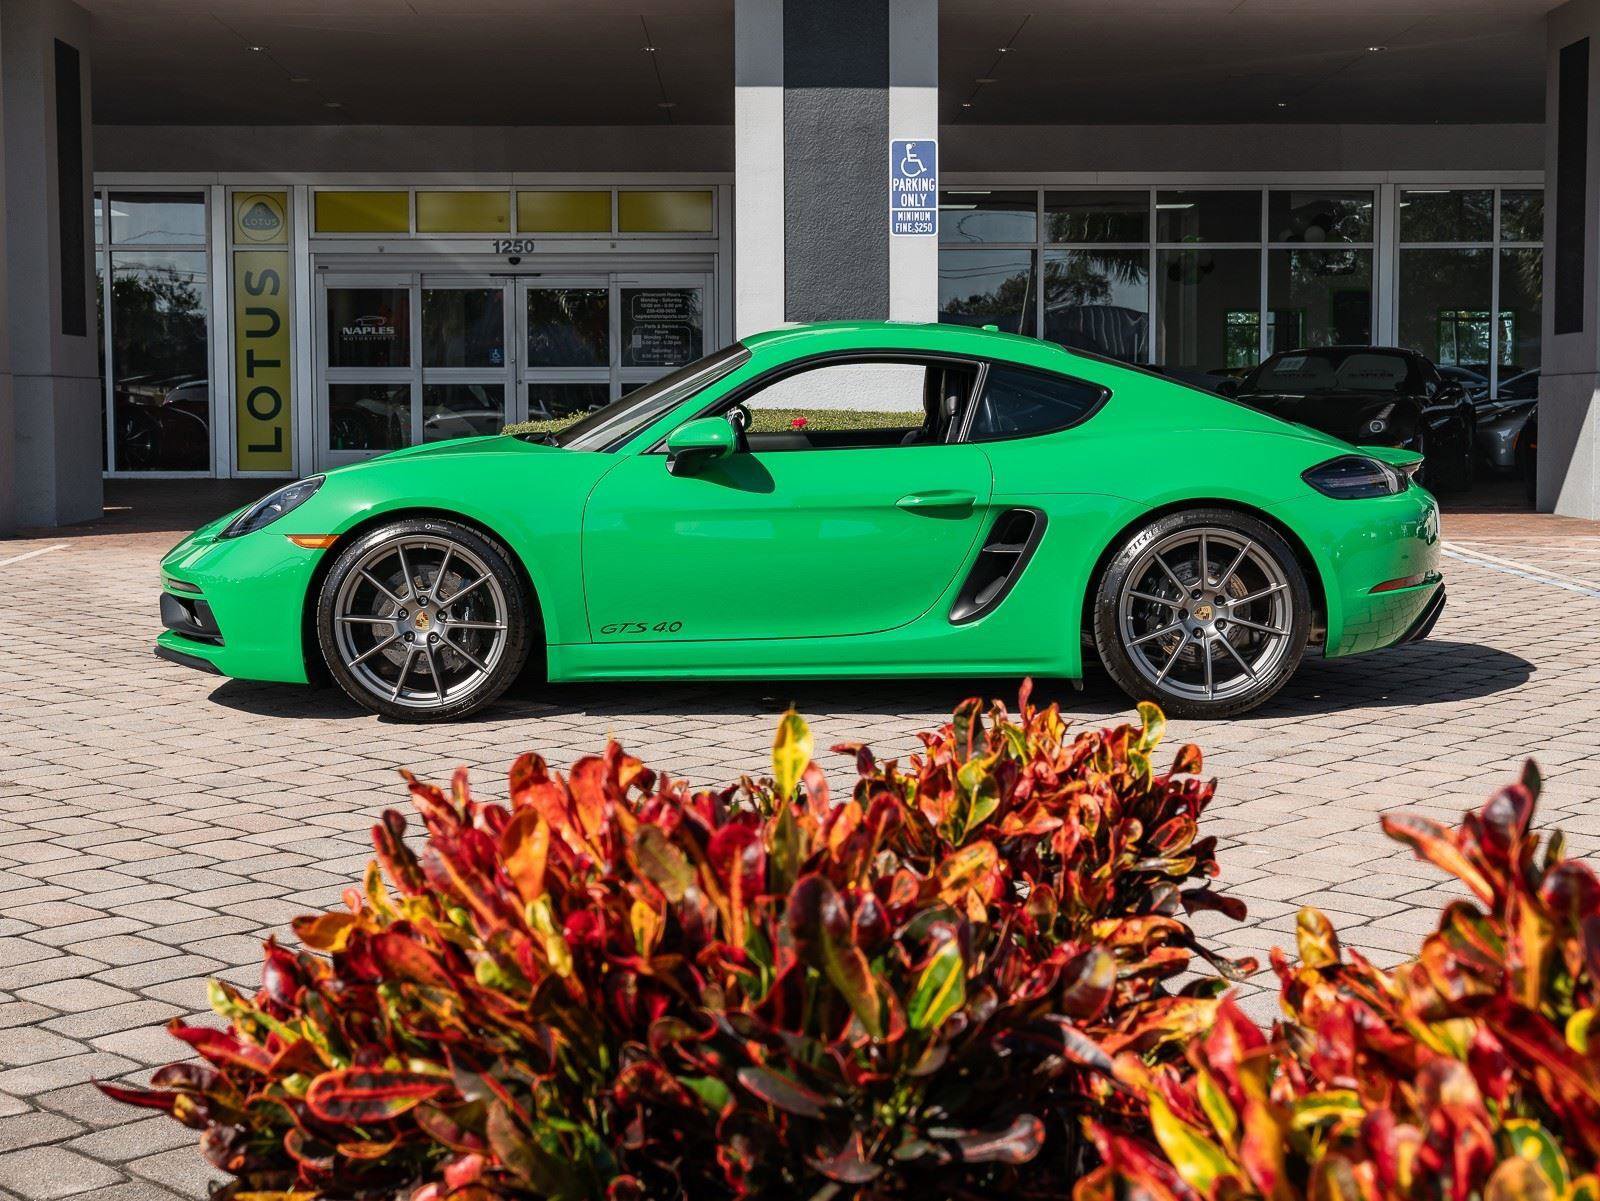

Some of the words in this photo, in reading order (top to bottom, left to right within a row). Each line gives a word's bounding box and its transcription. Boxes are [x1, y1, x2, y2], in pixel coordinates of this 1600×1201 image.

[893, 178, 935, 191] PARKING
[901, 194, 927, 206] ONLY
[245, 217, 278, 226] LOTUS
[897, 212, 930, 221] MINIMUM
[895, 223, 912, 232] FINE
[914, 222, 932, 233] $250
[492, 239, 535, 254] 1250
[342, 326, 395, 335] NAPLES
[244, 268, 282, 452] LOTUS
[600, 622, 648, 634] GTS
